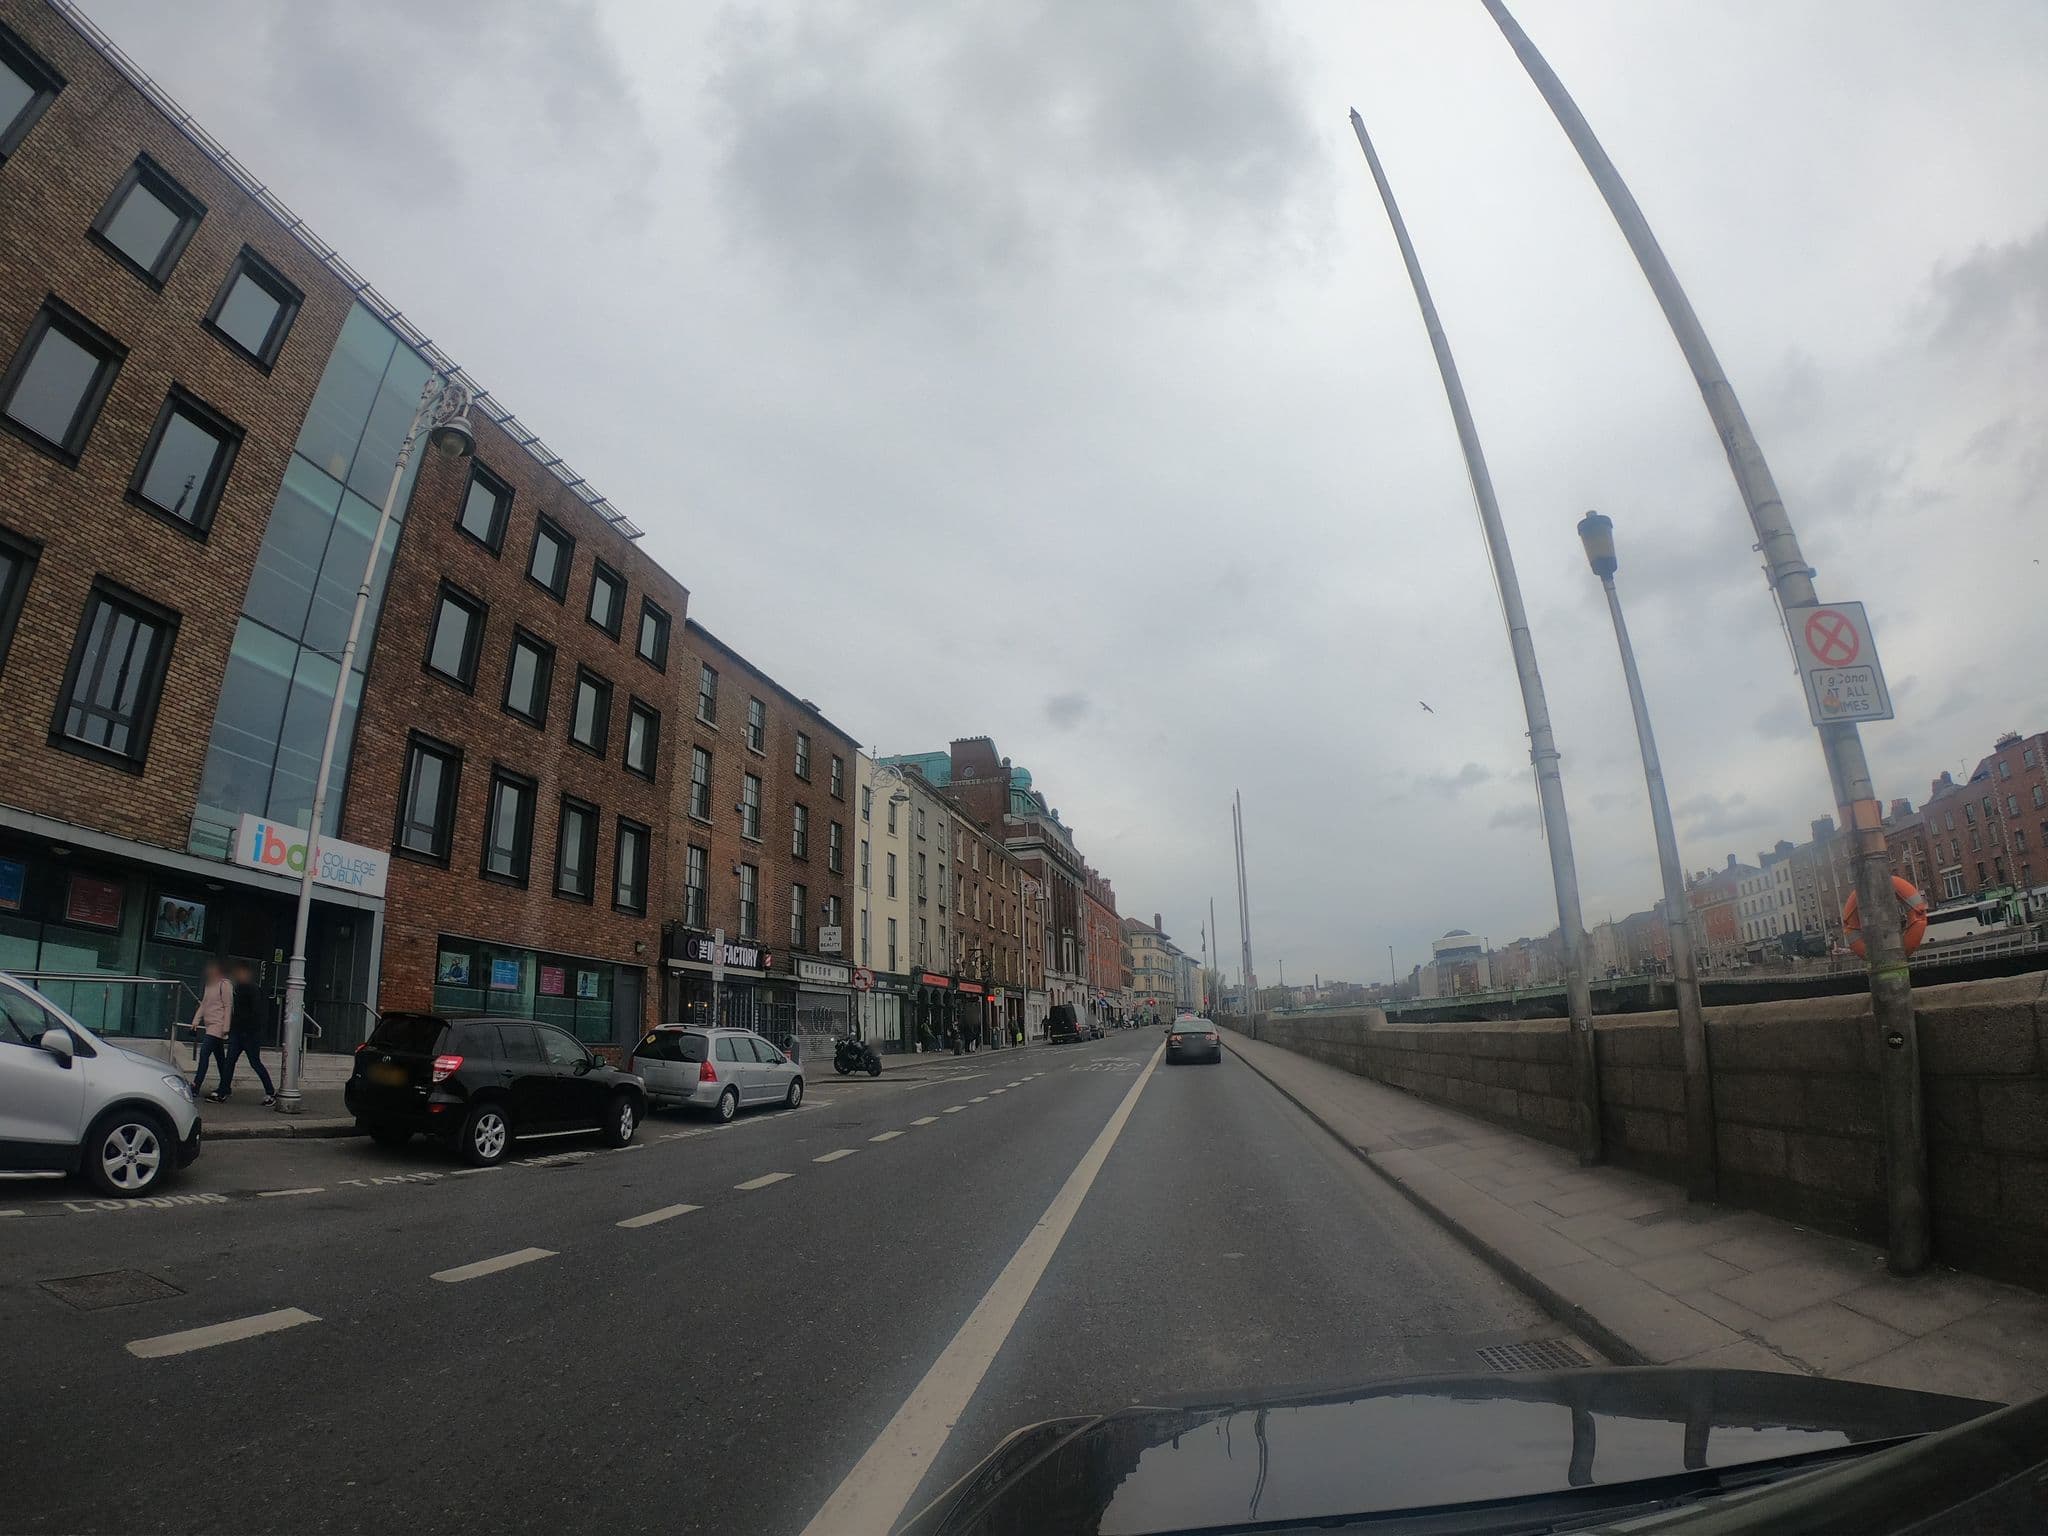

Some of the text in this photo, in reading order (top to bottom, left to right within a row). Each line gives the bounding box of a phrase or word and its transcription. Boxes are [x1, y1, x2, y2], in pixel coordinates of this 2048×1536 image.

[1847, 686, 1870, 698] ALL
[1840, 700, 1869, 713] IMES
[323, 852, 377, 876] COLLEGE
[321, 865, 363, 887] DUBLIN
[699, 940, 708, 960] THE
[724, 944, 758, 968] FACTORY
[63, 1193, 228, 1213] LOADING
